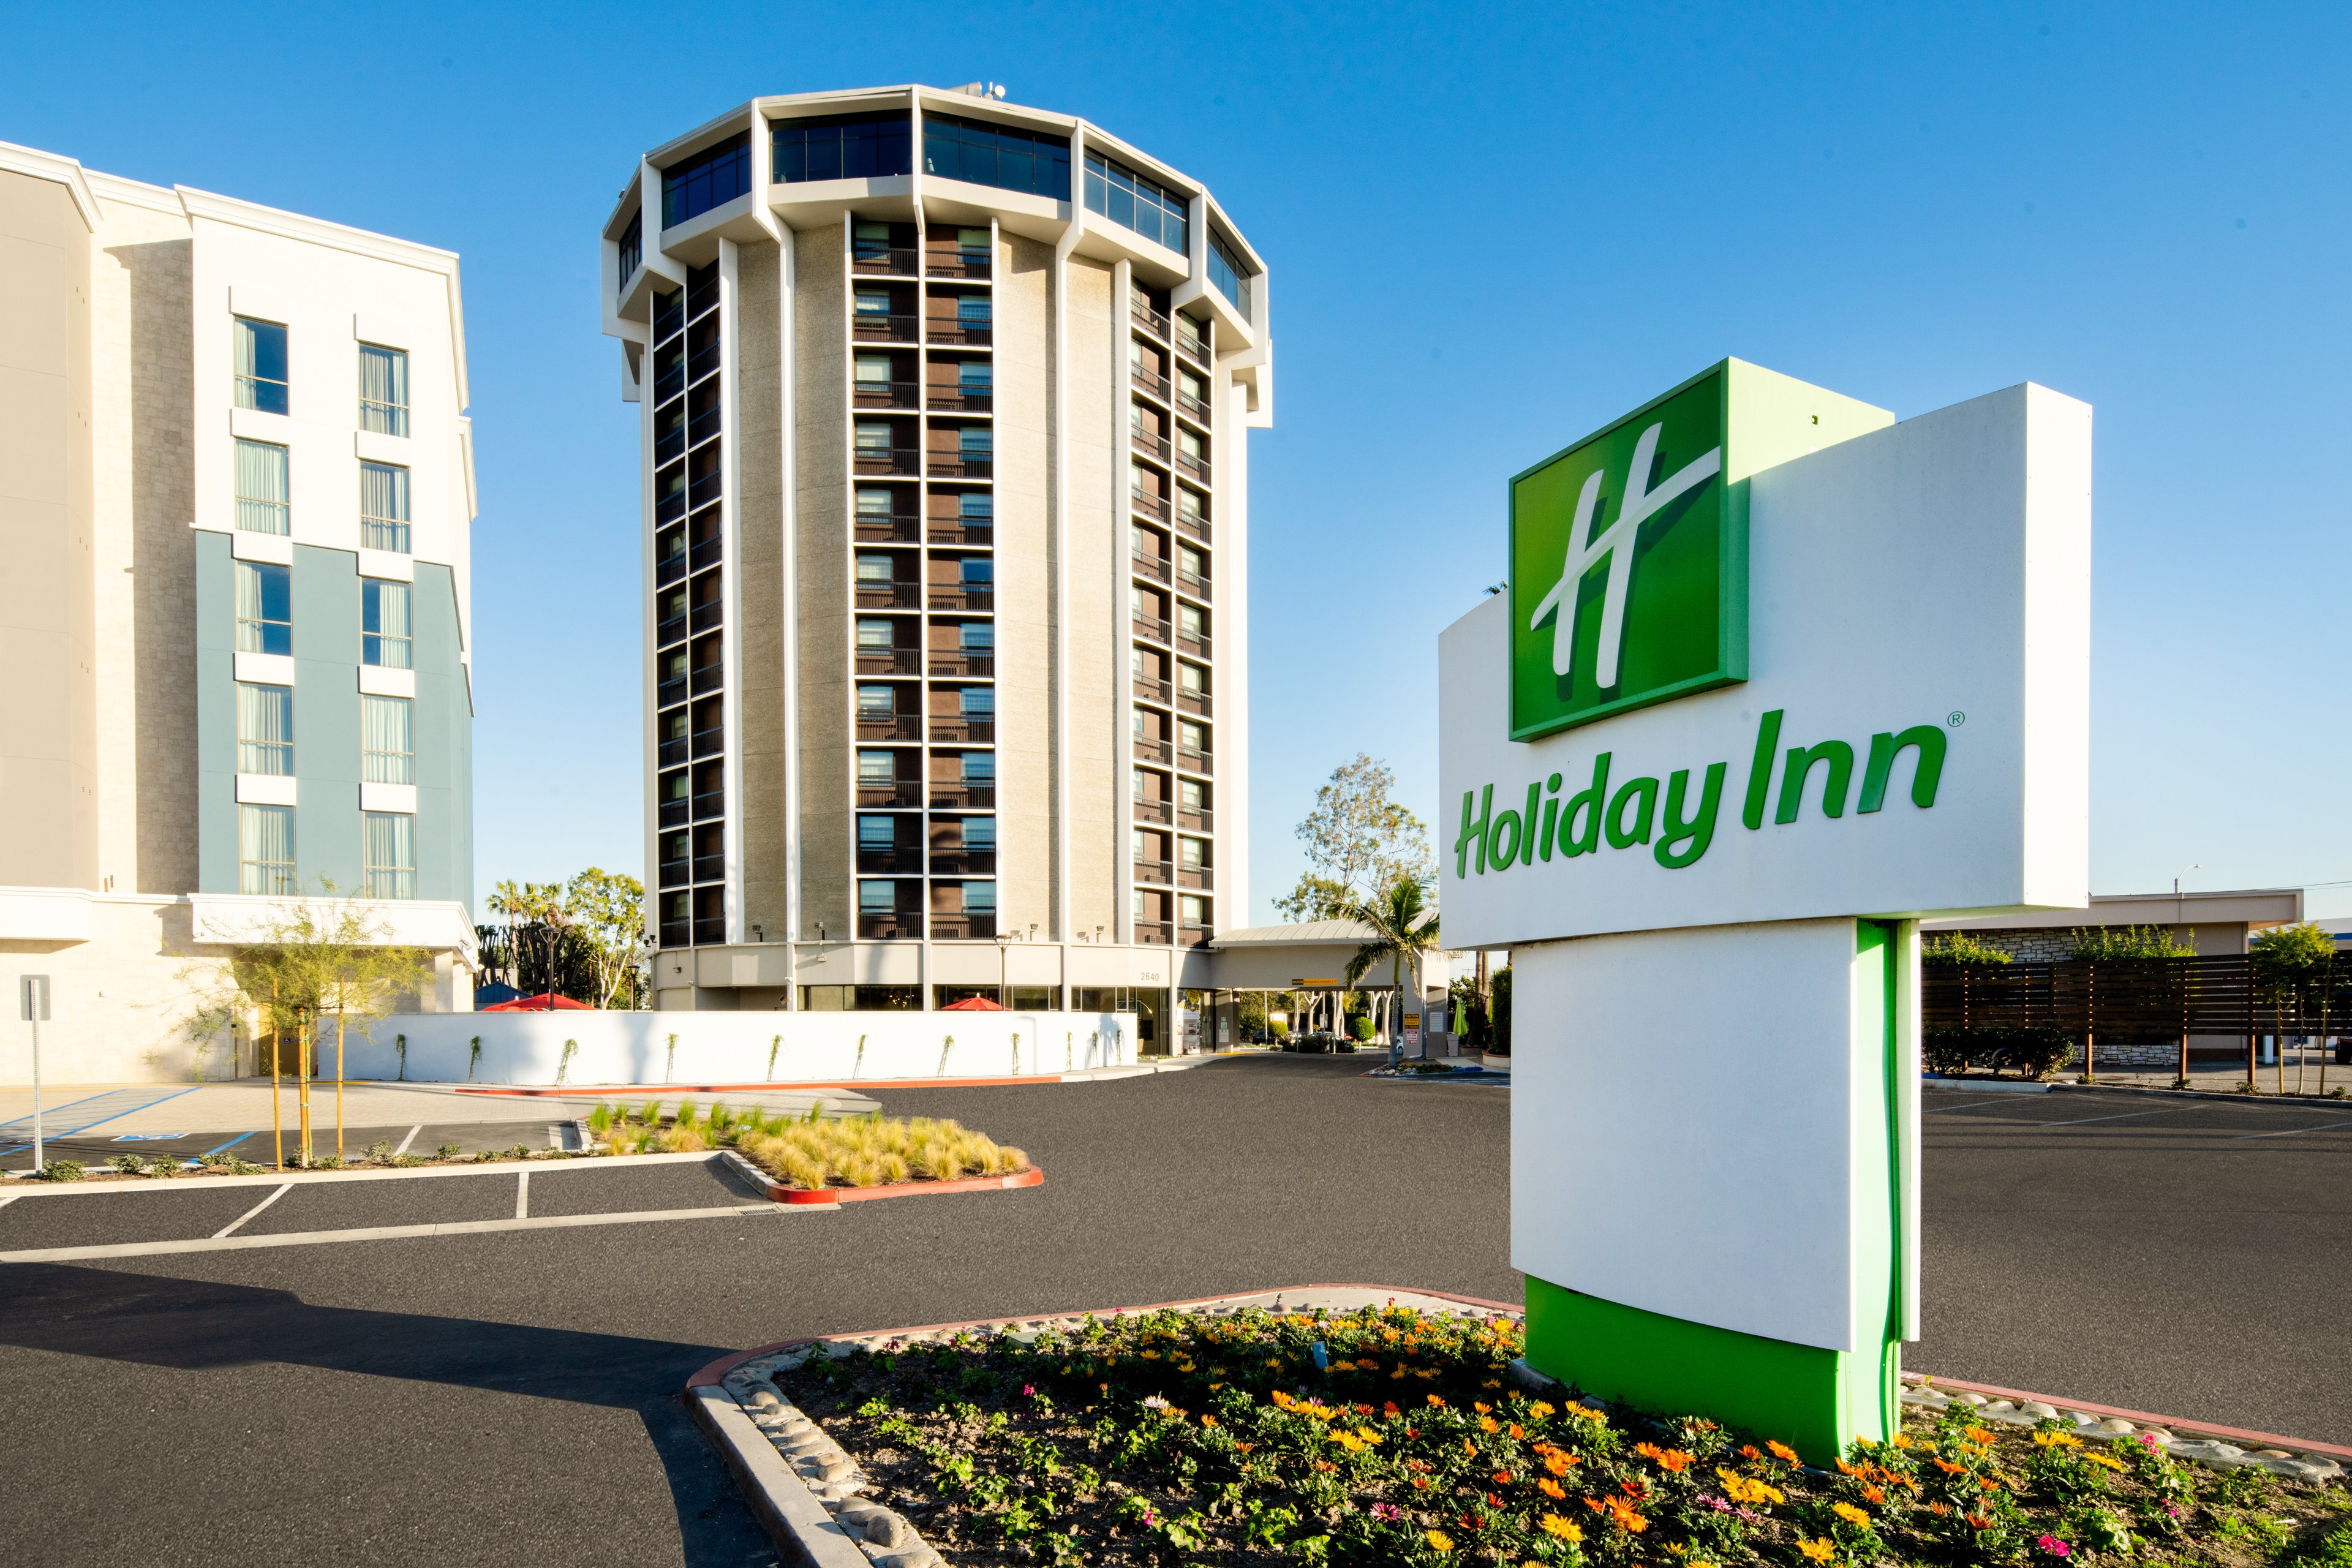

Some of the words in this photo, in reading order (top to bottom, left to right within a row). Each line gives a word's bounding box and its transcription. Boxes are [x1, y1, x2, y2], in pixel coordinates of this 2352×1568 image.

[1454, 752, 1727, 880] Holiday
[1743, 709, 1947, 830] Inn
[1140, 972, 1159, 981] 2640
